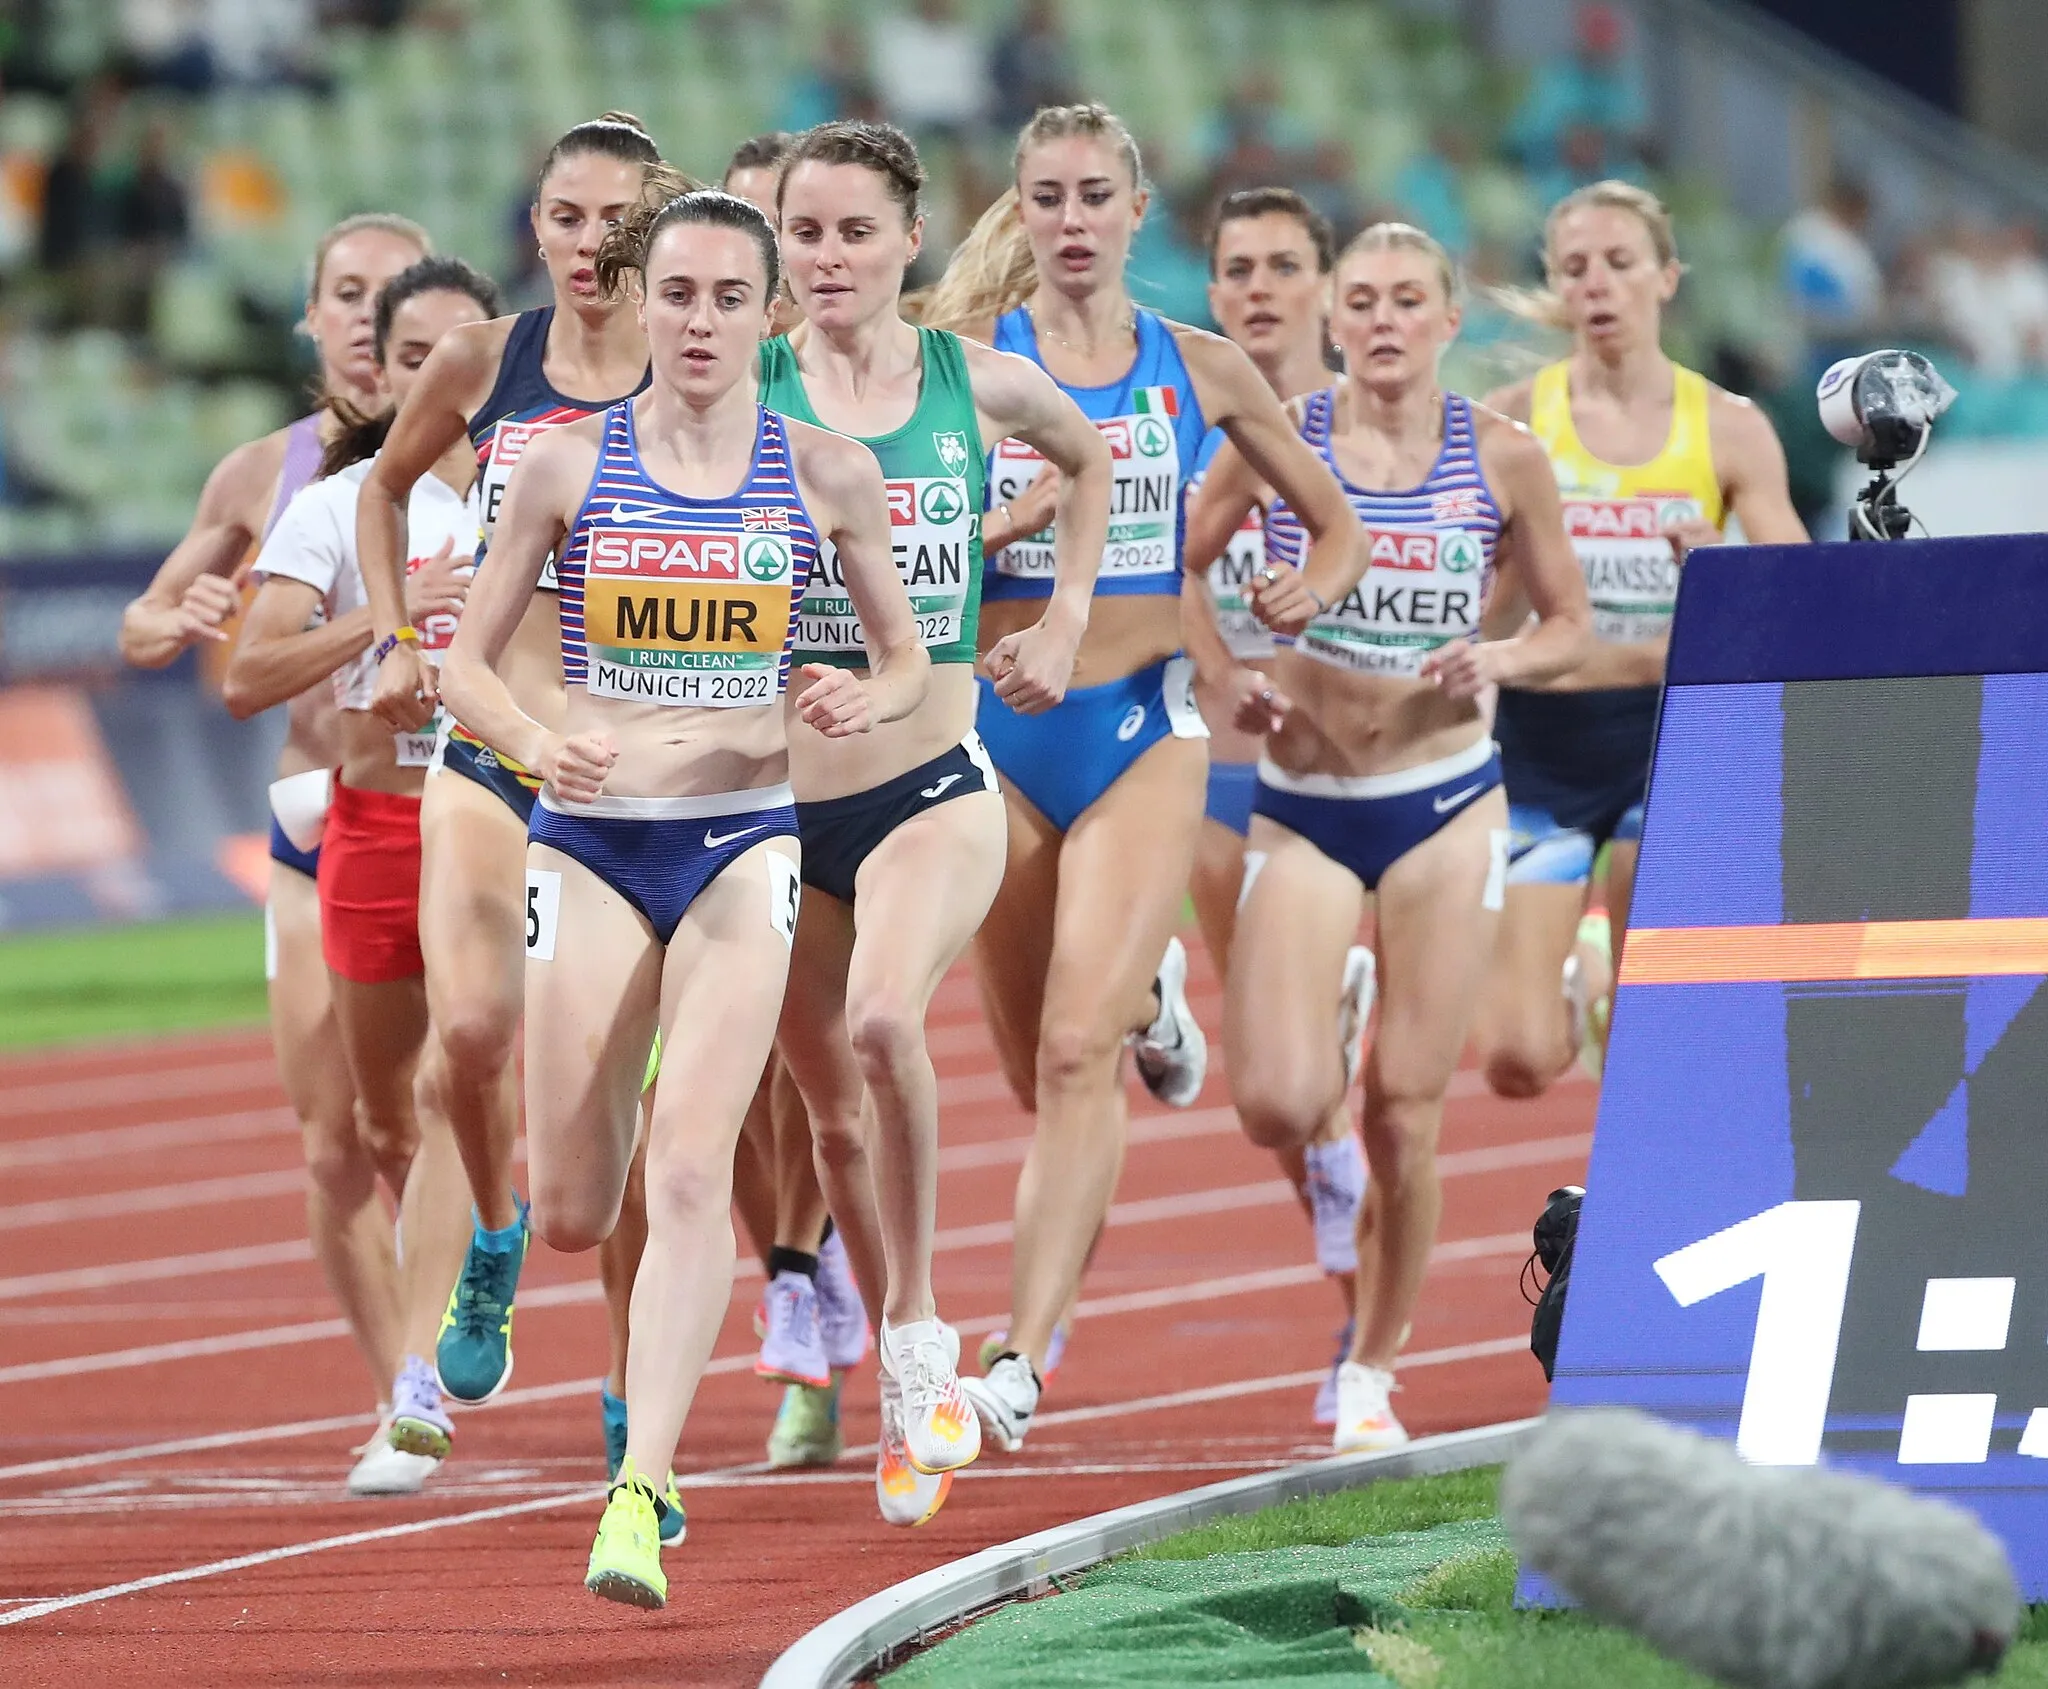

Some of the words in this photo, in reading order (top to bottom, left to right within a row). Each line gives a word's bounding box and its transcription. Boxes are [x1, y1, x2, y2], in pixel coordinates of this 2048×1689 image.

[999, 475, 1171, 516] STINI
[1564, 504, 1652, 537] PAR
[594, 536, 736, 573] SPAR
[1112, 544, 1166, 568] 2022
[1370, 533, 1436, 568] AR
[616, 596, 758, 642] MUIR
[1322, 583, 1471, 624] AKER
[799, 620, 864, 644] UNIC
[917, 615, 950, 639] 22
[629, 650, 635, 664] I
[639, 651, 675, 666] RUN
[597, 666, 700, 698] MUNICH
[711, 675, 768, 699] 2022
[527, 886, 540, 947] 5
[1652, 1199, 2048, 1466] 1:
